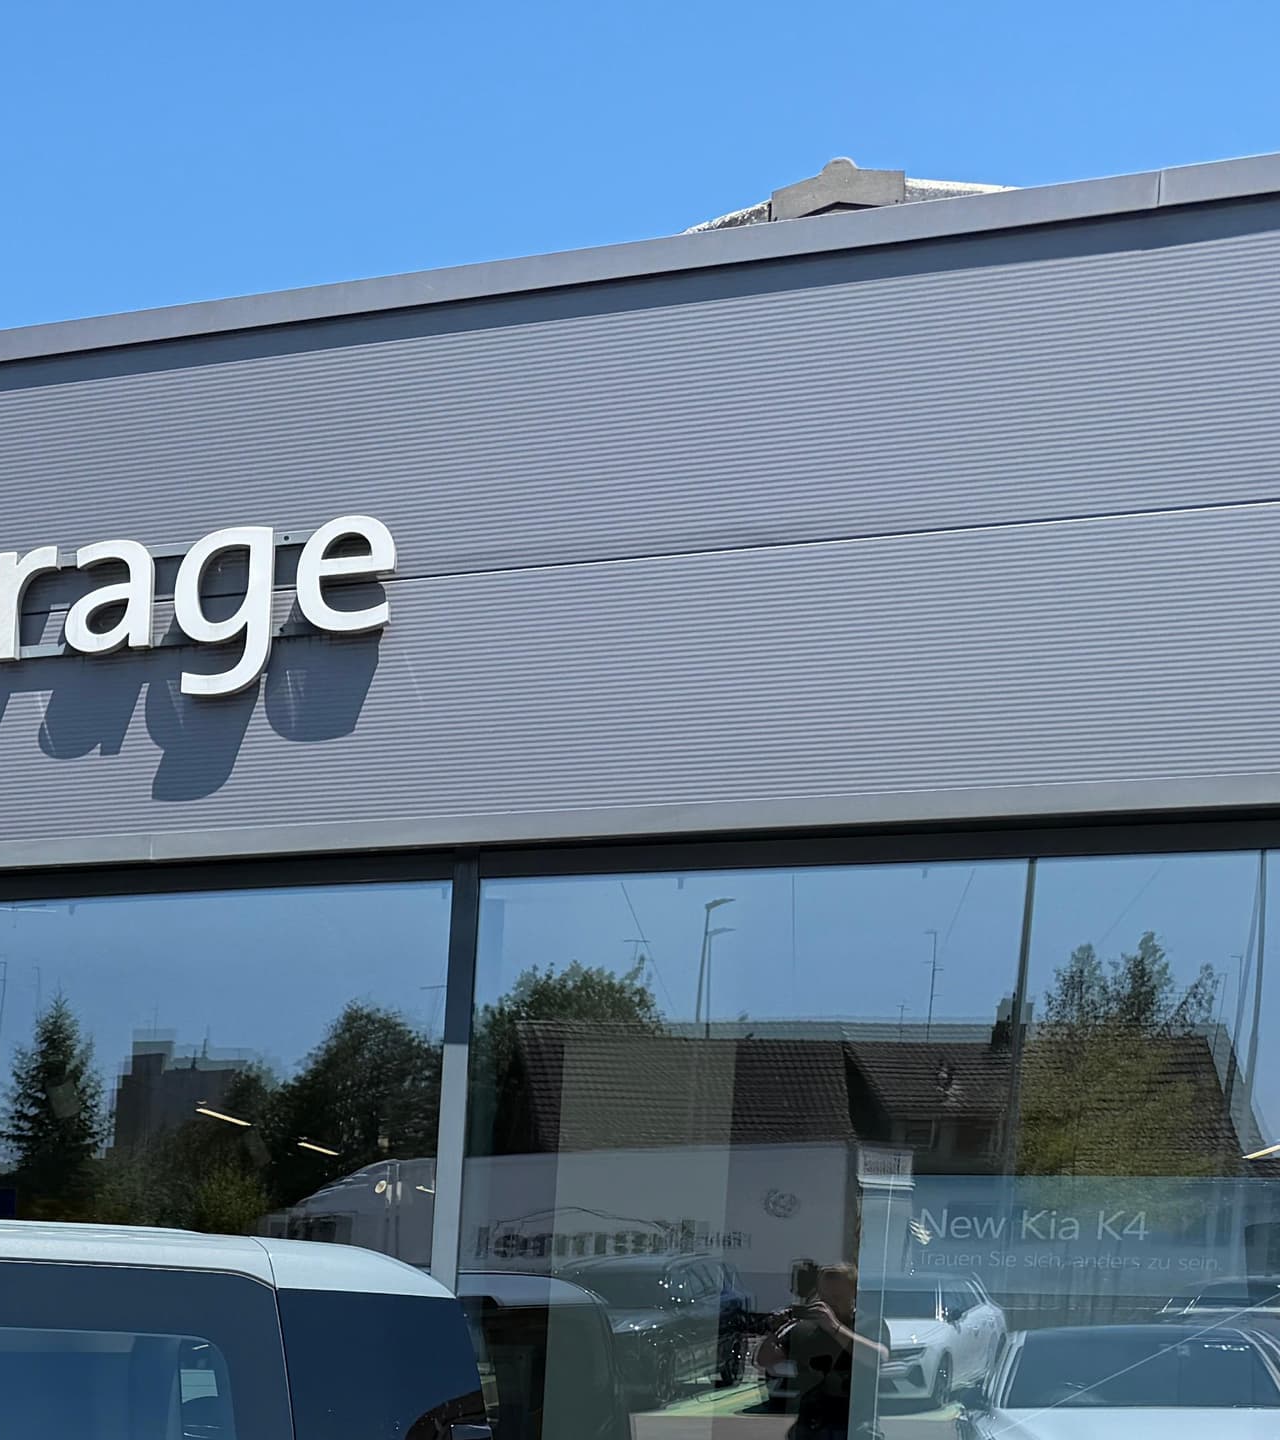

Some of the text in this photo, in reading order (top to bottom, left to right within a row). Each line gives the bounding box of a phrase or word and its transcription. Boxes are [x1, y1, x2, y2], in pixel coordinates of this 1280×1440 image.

[920, 1207, 1149, 1241] New Kia K4
[920, 1250, 982, 1267] Trauen
[990, 1251, 1017, 1268] Sie
[1072, 1253, 1141, 1270] anders
[1148, 1256, 1170, 1271] zu
